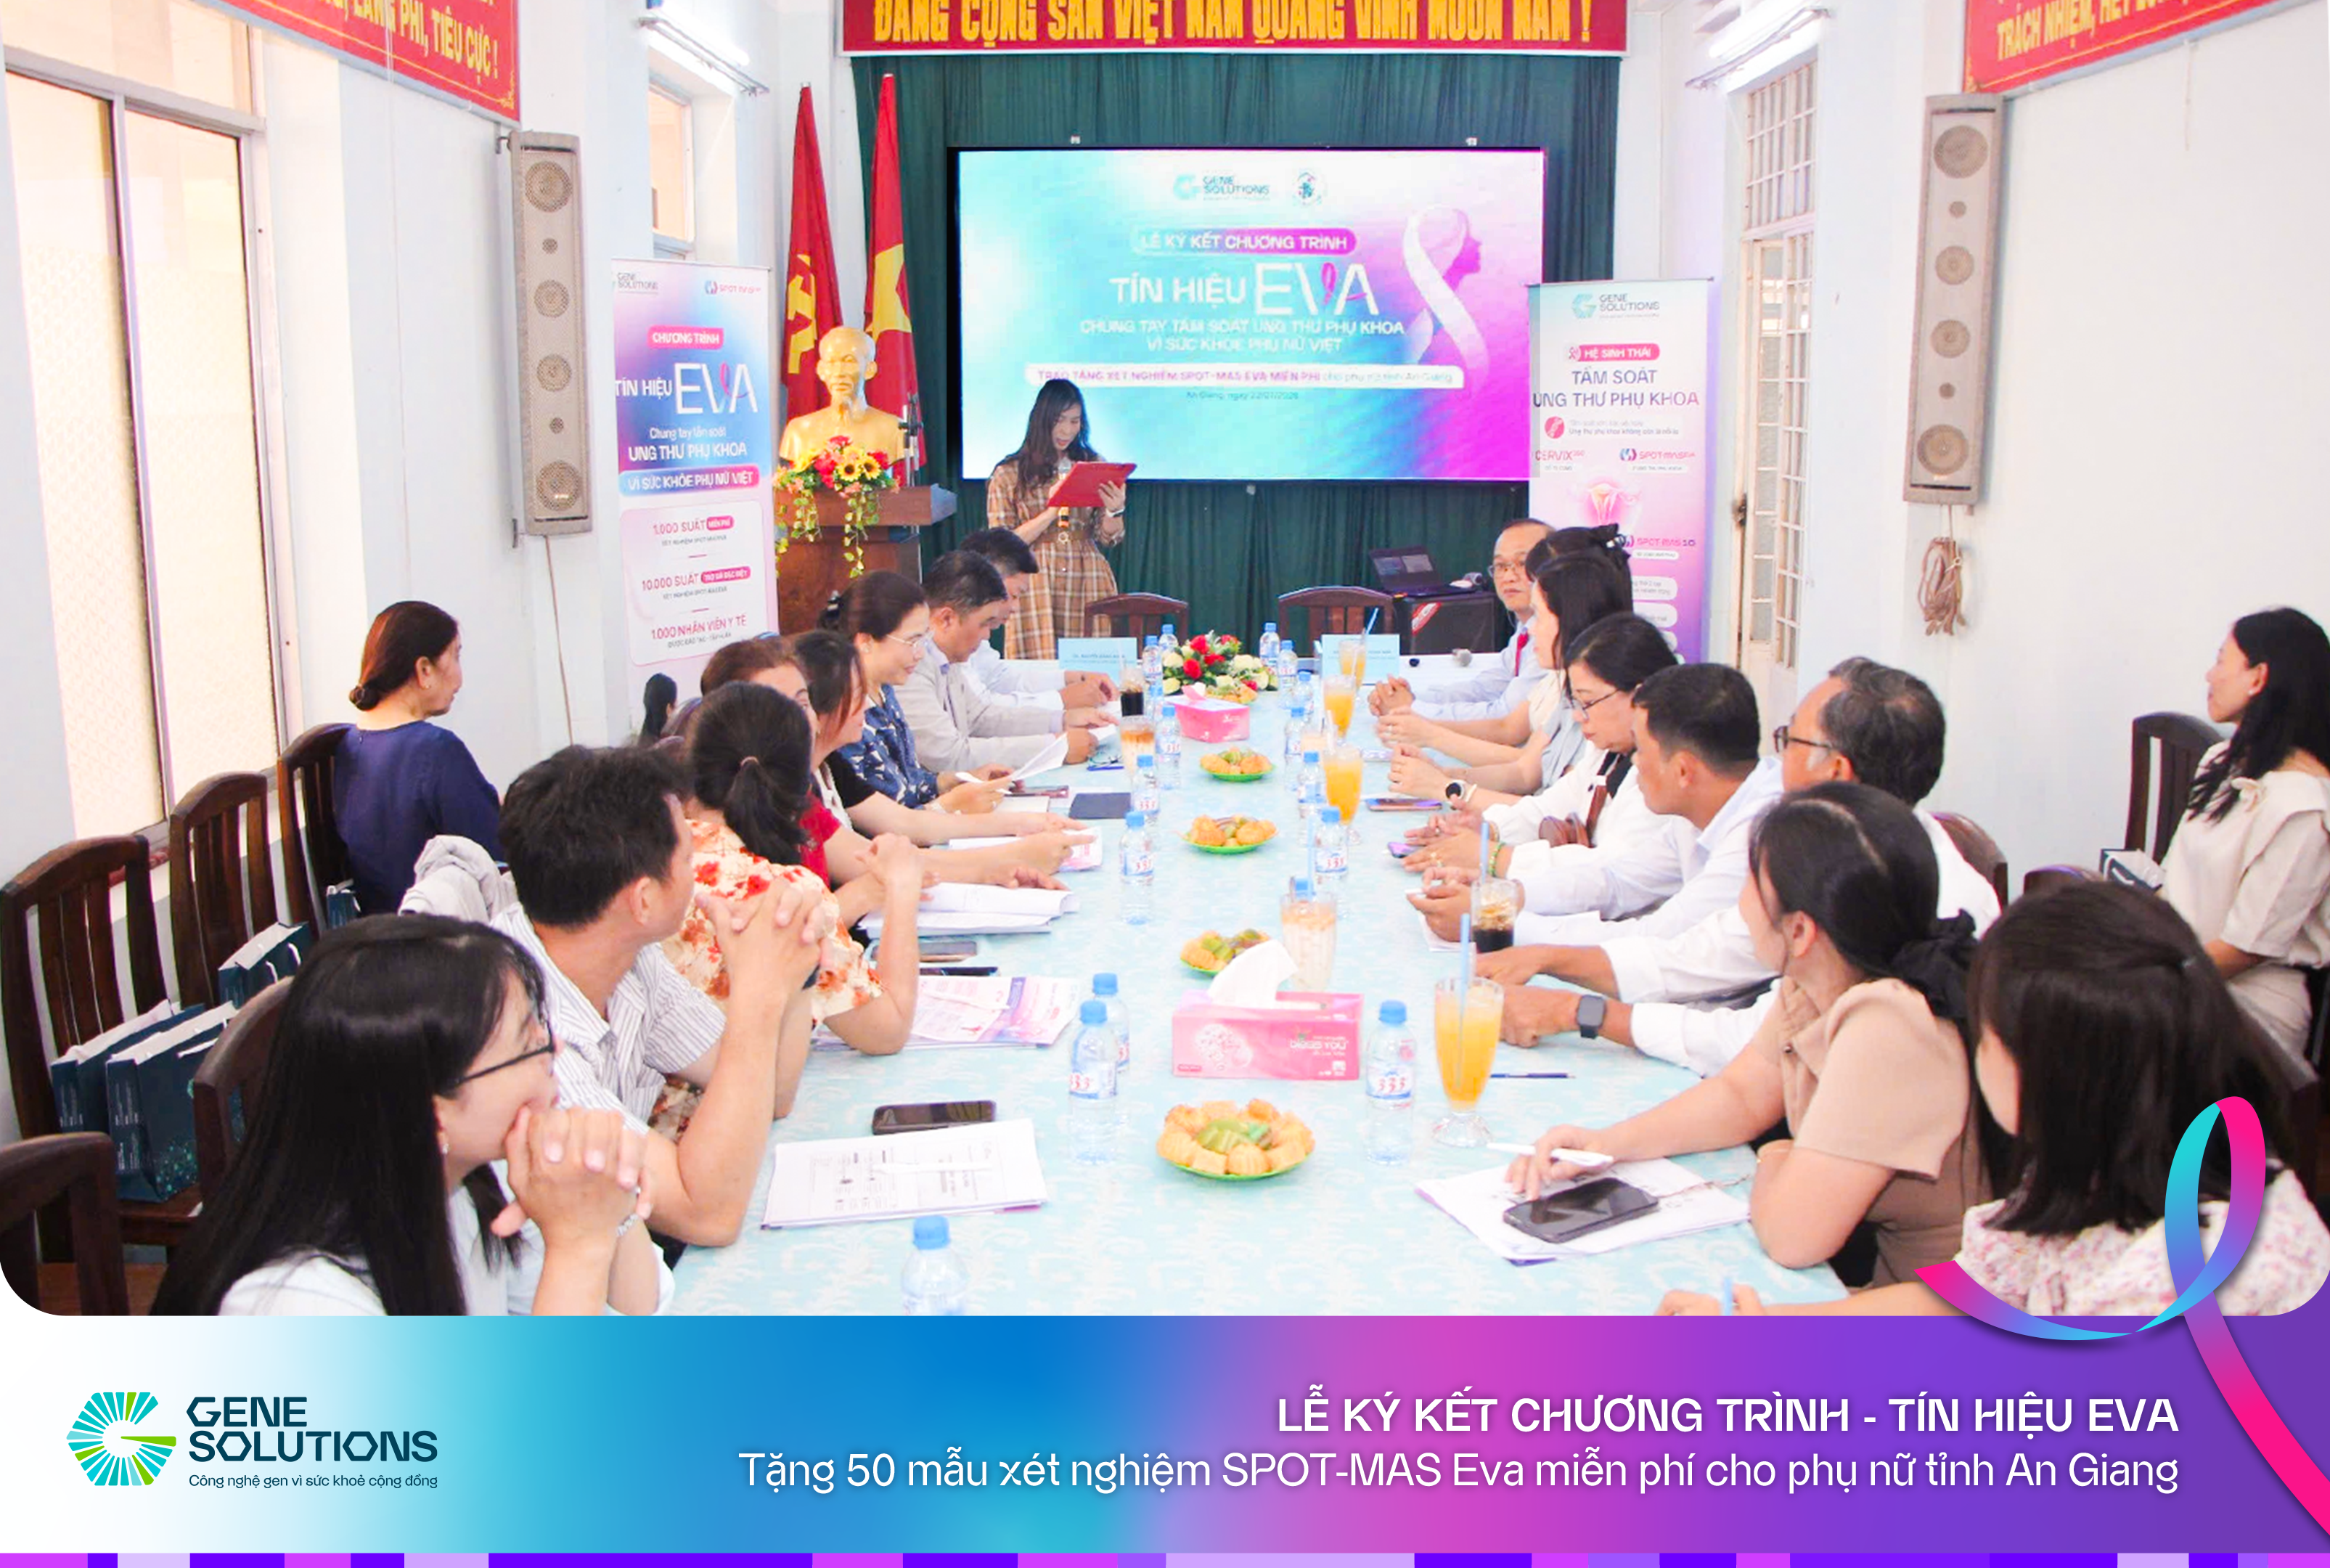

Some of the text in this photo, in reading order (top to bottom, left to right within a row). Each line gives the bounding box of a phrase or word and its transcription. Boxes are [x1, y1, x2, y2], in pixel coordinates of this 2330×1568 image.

[1186, 0, 1244, 39] NAM
[1252, 0, 1346, 44] QUANG
[1354, 0, 1418, 40] VINH
[1998, 2, 2043, 62] TRÁCH
[431, 6, 462, 64] TIÊU
[465, 24, 491, 86] CỰC
[1203, 184, 1271, 195] SOLUTIONS
[1300, 233, 1347, 250] TRÌNH
[1108, 261, 1380, 315] TÍN HIỆU EVA
[1599, 293, 1627, 303] GENE
[1599, 301, 1660, 312] SOLUTIONS
[1325, 321, 1357, 336] PHỤ
[1360, 321, 1405, 335] KHOA
[653, 331, 719, 345] CHƯƠNG TRÌNH
[1601, 348, 1625, 359] SINH
[1627, 345, 1652, 358] THÁI
[1612, 367, 1658, 385] SOÁT
[616, 362, 759, 414] TÍN HIỆU EVA
[1572, 391, 1606, 407] THƯ
[1610, 392, 1644, 409] PHỤ
[1649, 391, 1700, 407] KHOA
[629, 445, 658, 462] UNG
[688, 444, 710, 460] PHỤ
[713, 442, 748, 457] KHOA
[695, 473, 714, 489] PHỤ
[727, 618, 734, 628] Y
